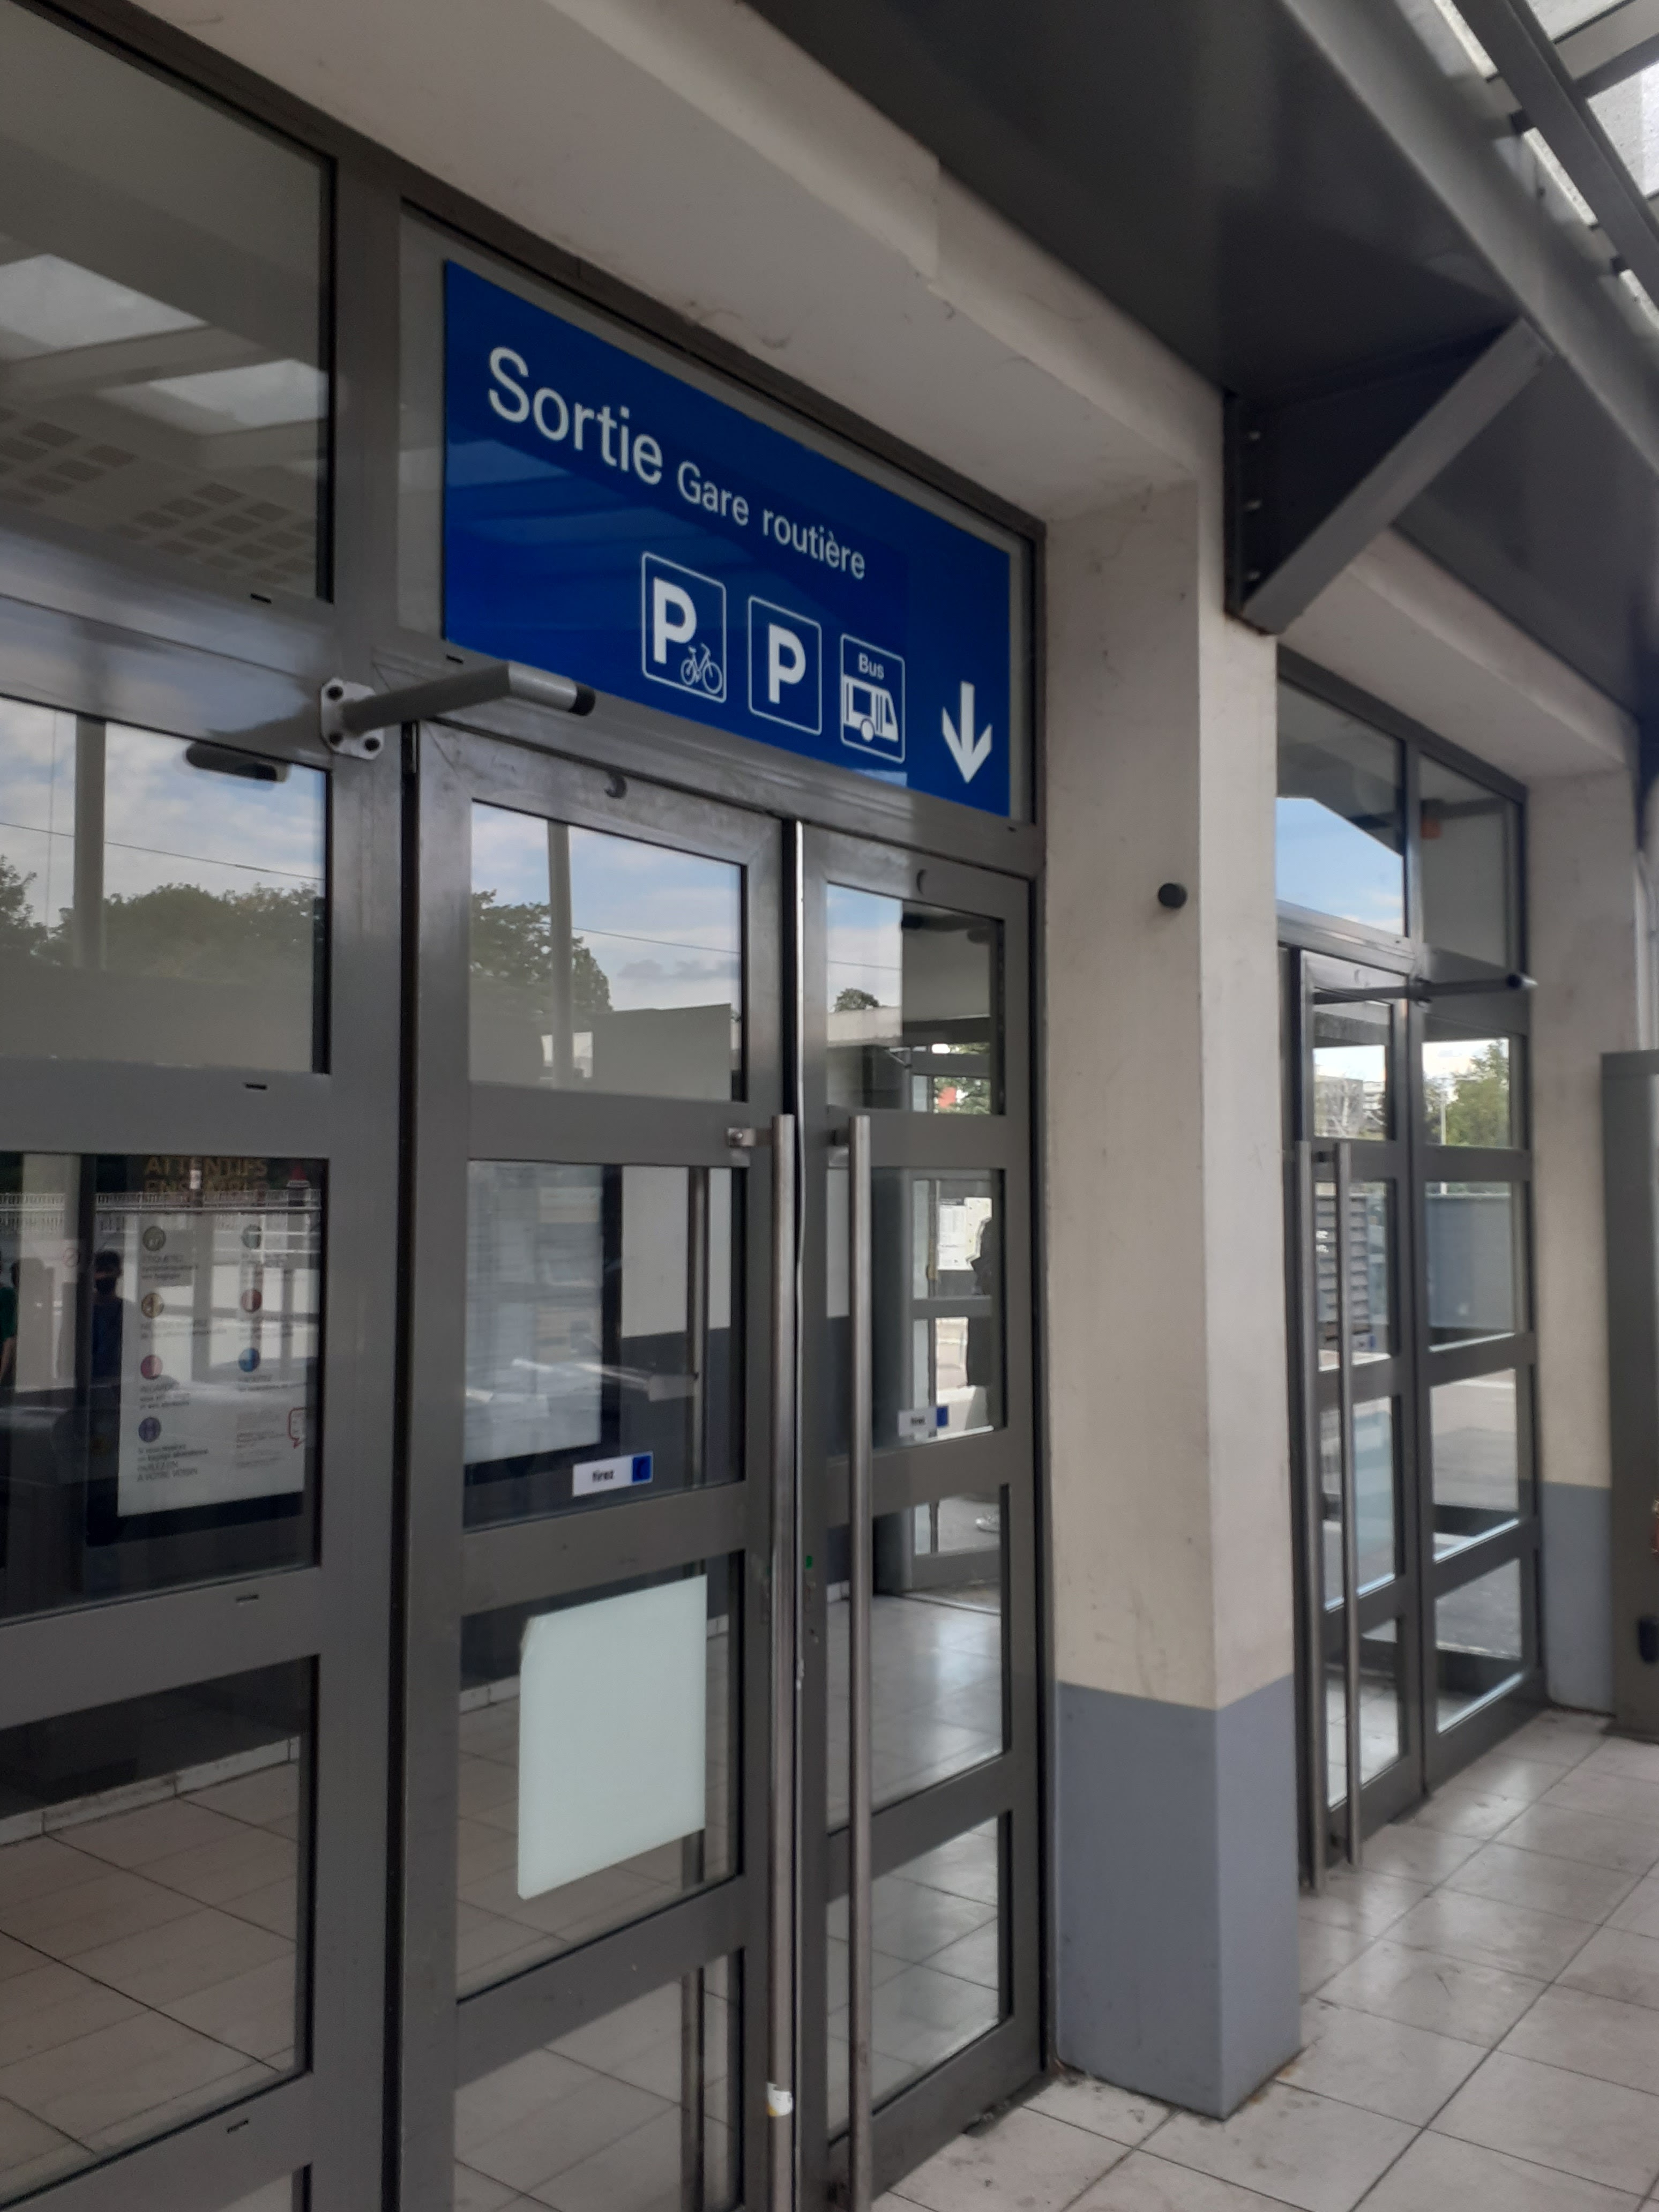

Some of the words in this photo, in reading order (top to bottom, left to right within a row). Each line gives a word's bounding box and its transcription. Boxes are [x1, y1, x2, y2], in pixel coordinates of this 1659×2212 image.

[489, 346, 662, 484] Sortie
[677, 460, 749, 526] Gare
[763, 508, 865, 579] routière
[653, 577, 697, 664] P
[768, 623, 806, 704] P
[858, 653, 884, 680] Bus
